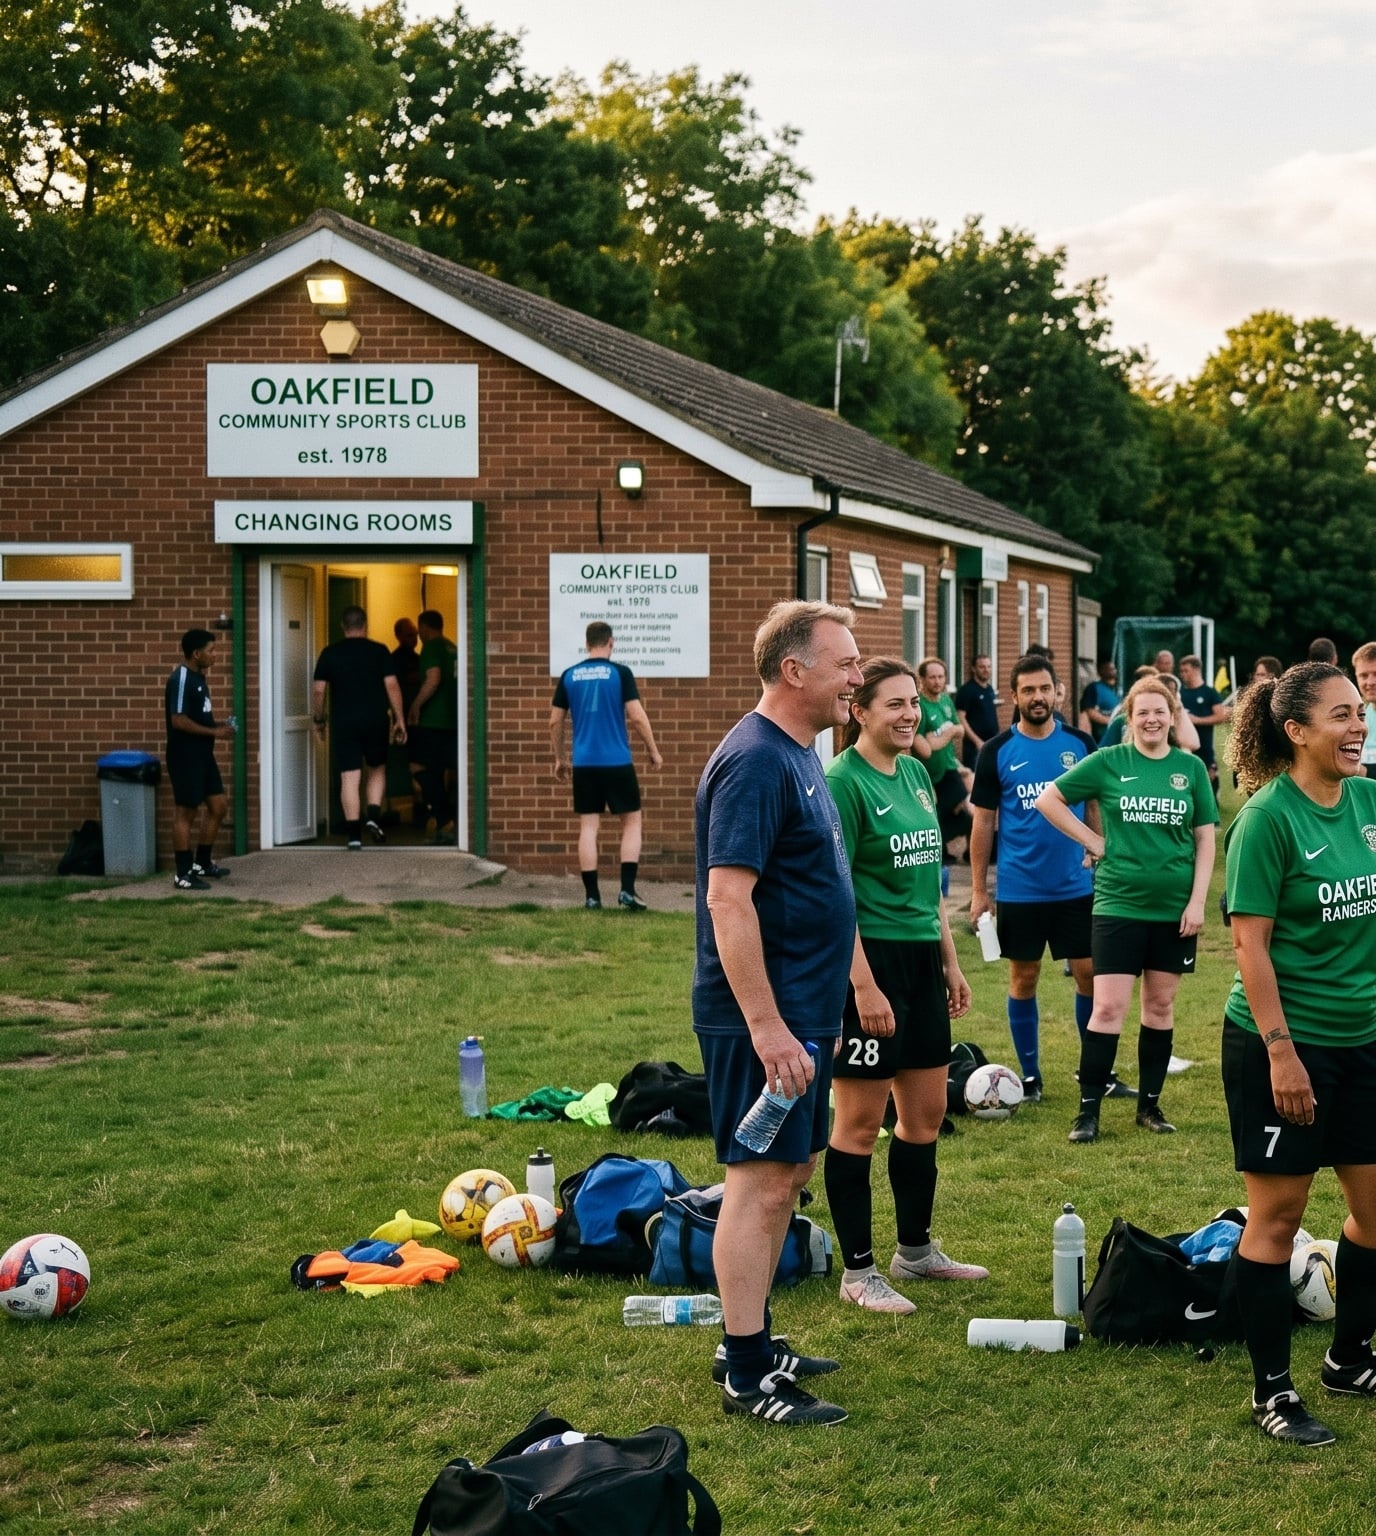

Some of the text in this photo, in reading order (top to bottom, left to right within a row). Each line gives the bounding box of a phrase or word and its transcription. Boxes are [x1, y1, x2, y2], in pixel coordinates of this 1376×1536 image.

[251, 378, 434, 405] OAKFIELD
[219, 414, 466, 429] COMMUNITY SPORTS CLUB
[298, 447, 387, 464] est. 1978
[235, 513, 452, 531] CHANGING ROOMS
[581, 564, 677, 580] OAKFIELD
[559, 584, 699, 595] COMMUNITY SPORTS CLUB
[1119, 796, 1187, 815] OAKFIELD
[1123, 811, 1183, 826] RANGERS SC
[890, 828, 941, 853] OAKFIEL
[1322, 898, 1376, 922] RANGERS
[848, 1037, 880, 1066] 28
[1264, 1125, 1281, 1158] 7
